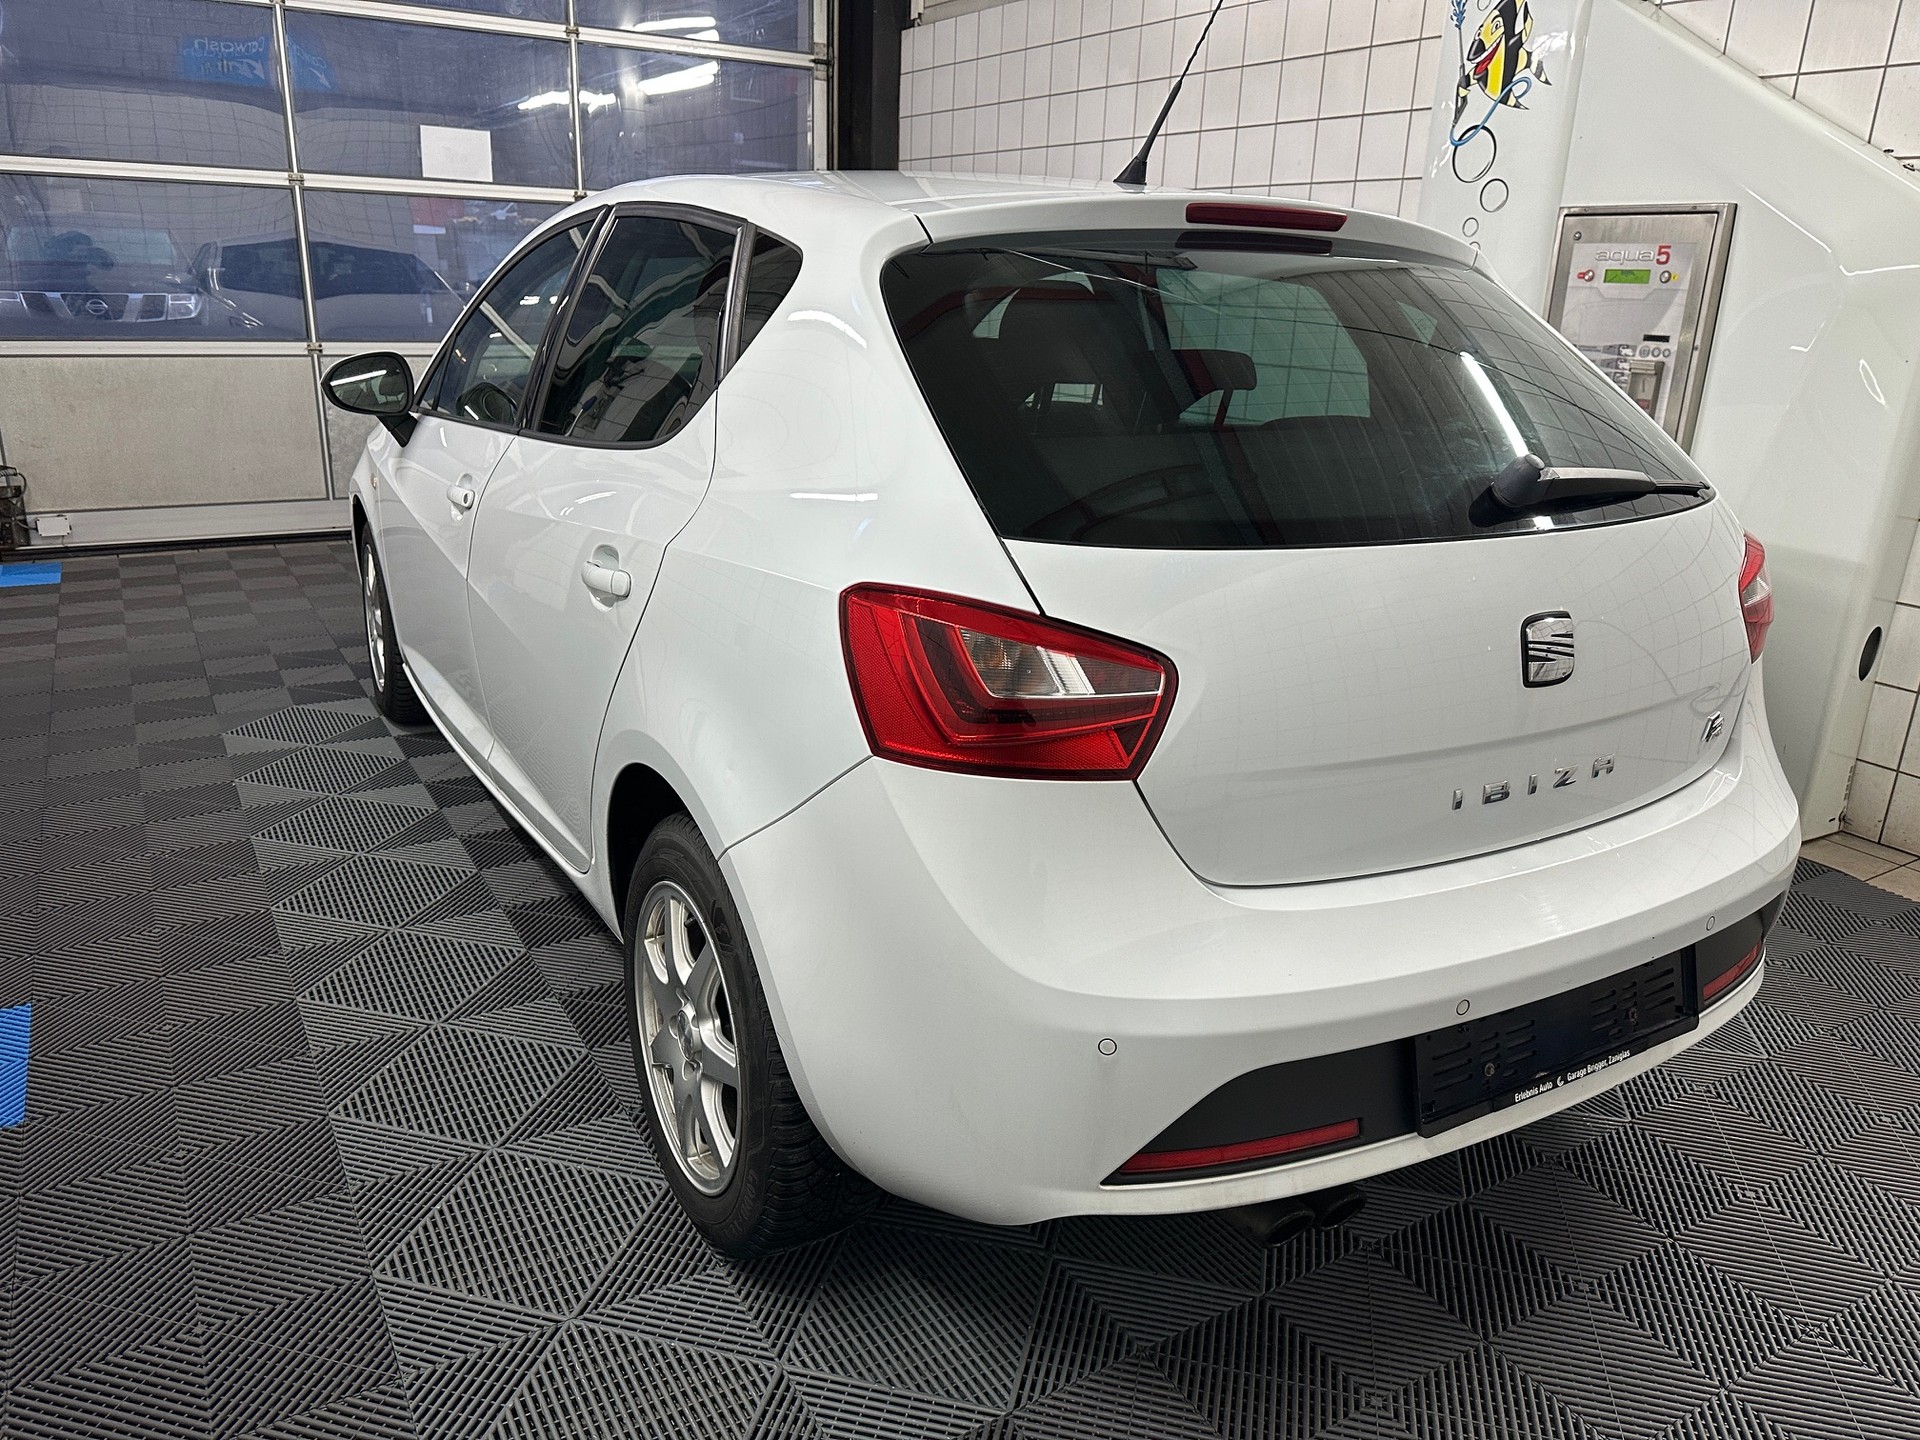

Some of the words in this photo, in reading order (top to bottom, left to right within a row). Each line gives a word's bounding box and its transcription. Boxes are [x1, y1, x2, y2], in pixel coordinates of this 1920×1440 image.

[1452, 753, 1615, 810] IBIZA
[1514, 1086, 1538, 1102] Erlebnis
[1539, 1081, 1552, 1092] Auto
[1567, 1068, 1587, 1081] Garage
[1587, 1059, 1608, 1074] Brigger,
[1608, 1049, 1630, 1064] Zaniglas
